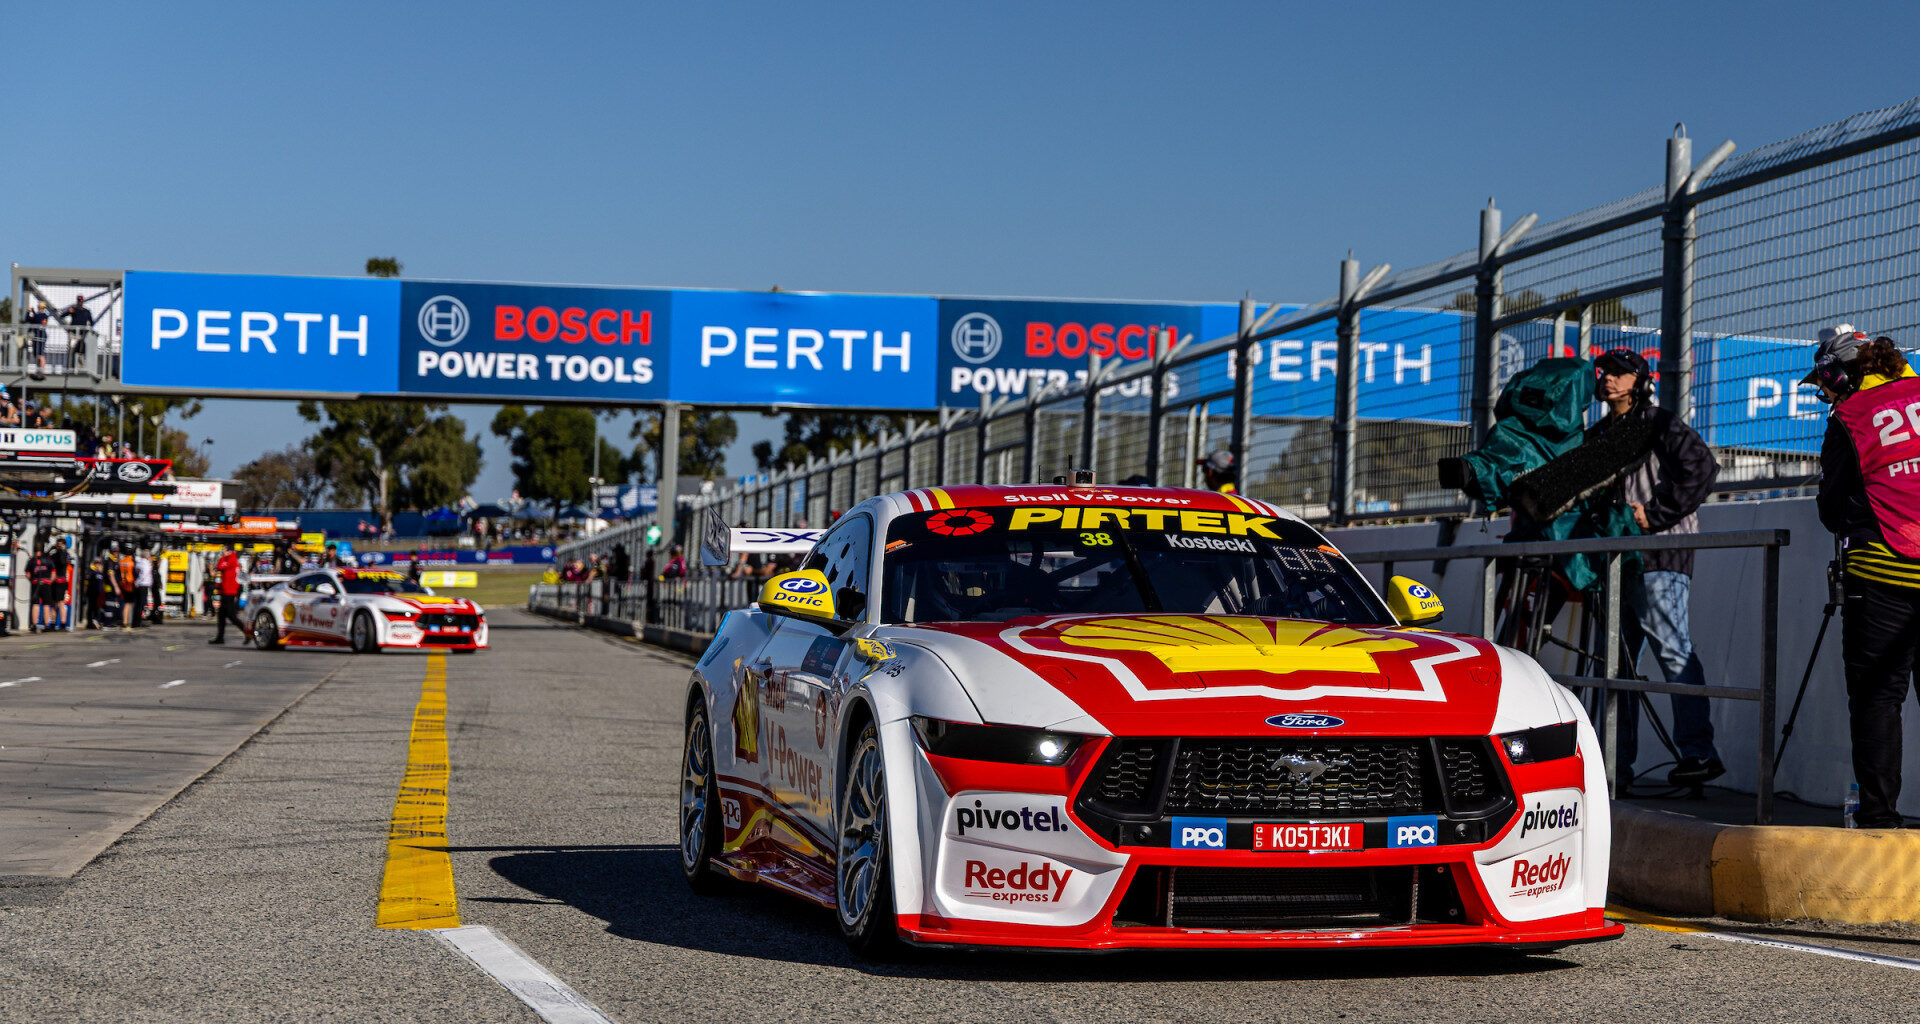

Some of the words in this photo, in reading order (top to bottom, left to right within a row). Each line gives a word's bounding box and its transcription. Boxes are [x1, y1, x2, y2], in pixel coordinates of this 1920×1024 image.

[151, 308, 368, 356] PERTH
[494, 305, 653, 346] BOSCH
[700, 325, 911, 372] PERTH
[417, 350, 539, 381] POWER
[545, 355, 654, 385] TOOLS
[24, 433, 72, 445] OPTUS
[1003, 493, 1069, 503] Shell
[1073, 494, 1191, 505] V-Power
[1008, 507, 1283, 540] PIRTEK
[1079, 532, 1114, 547] 38
[1164, 533, 1258, 553] Kostecki
[773, 592, 823, 606] Doric
[1281, 714, 1329, 727] Ford
[765, 717, 823, 805] V-Power
[956, 800, 1068, 836] pivotel.
[1520, 802, 1579, 839] pivotel.
[1182, 827, 1224, 847] PPQ
[1397, 825, 1435, 845] PPQ
[965, 859, 1074, 903] Reddy
[1511, 852, 1571, 889] Reddy
[992, 891, 1049, 904] express
[1527, 883, 1558, 898] express
